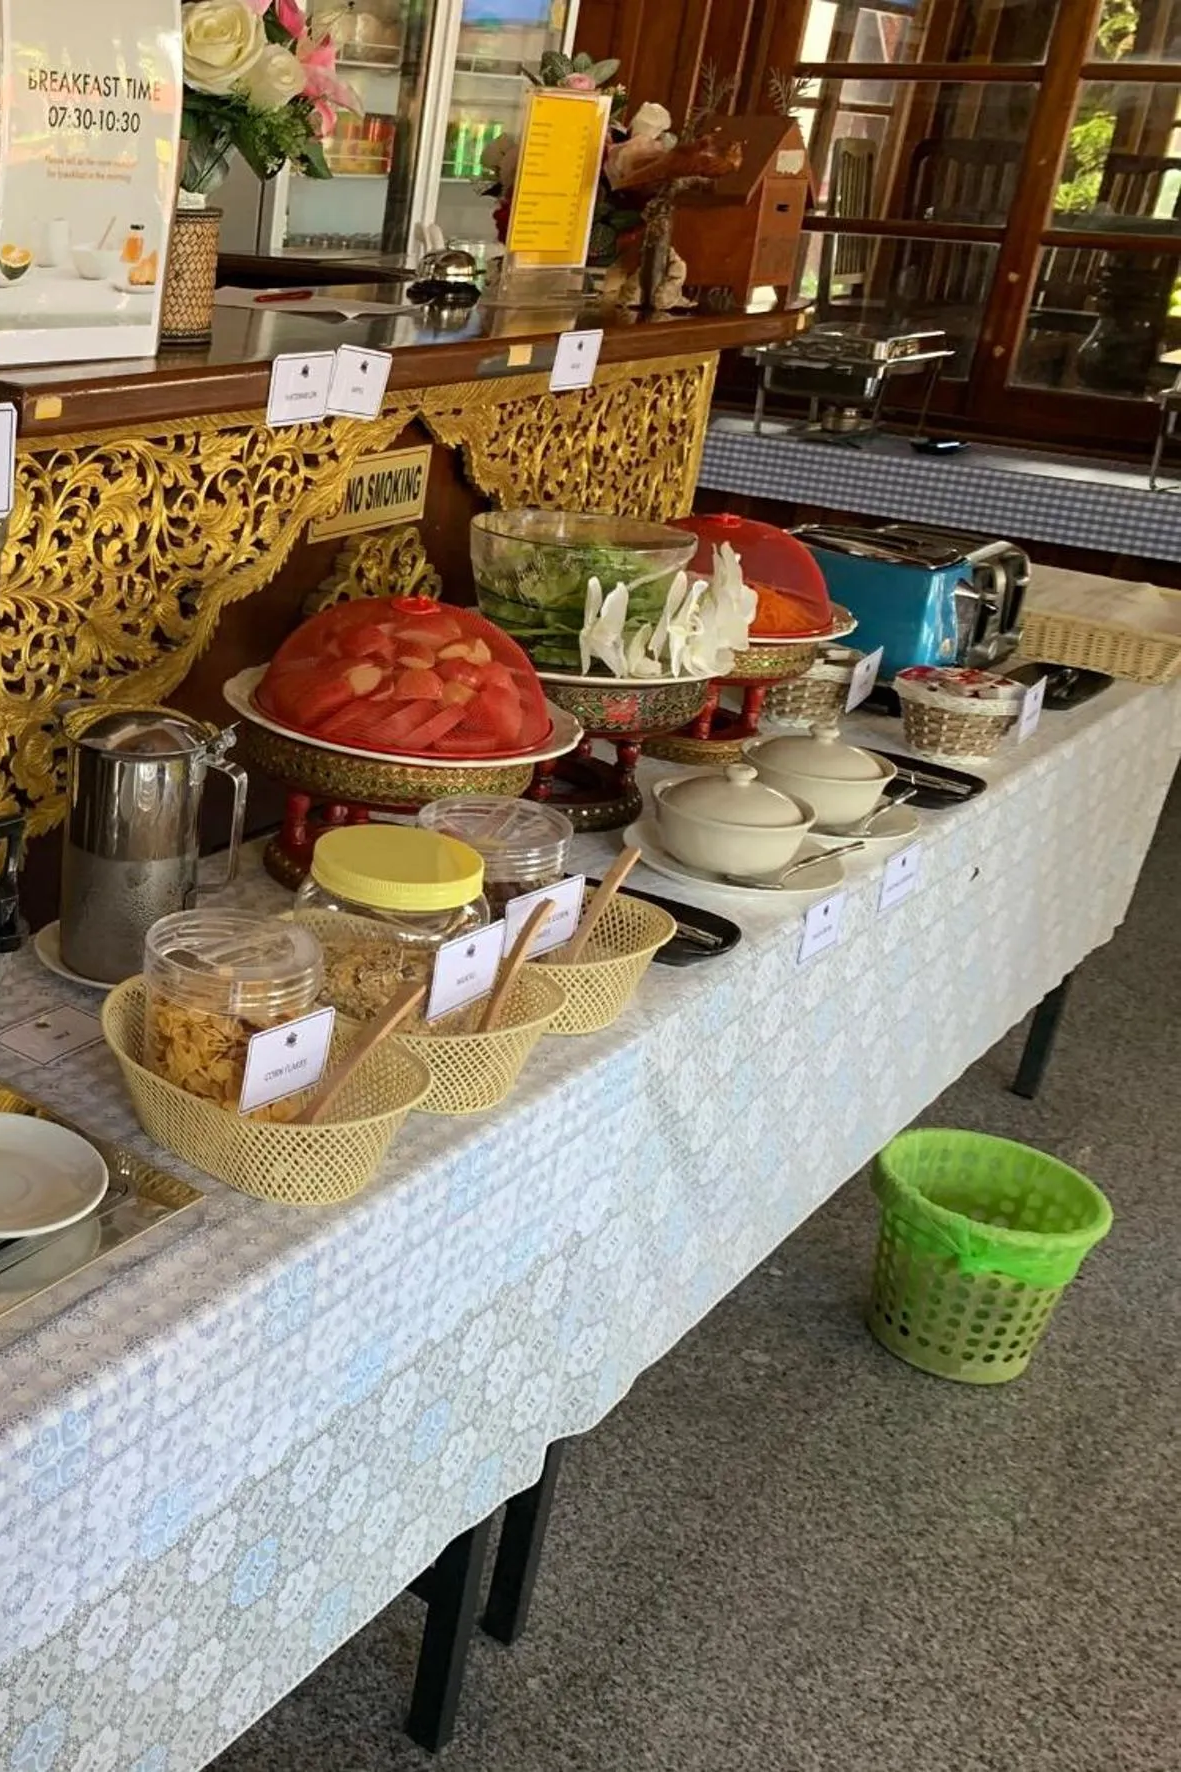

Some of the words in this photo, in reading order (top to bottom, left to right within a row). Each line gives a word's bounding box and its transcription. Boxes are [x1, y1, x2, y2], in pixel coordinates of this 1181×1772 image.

[27, 68, 121, 98] BREAKFAST
[125, 78, 162, 102] TIME
[47, 105, 141, 133] 07:30-10:30
[343, 475, 364, 515] NO
[365, 465, 422, 511] SMOKING
